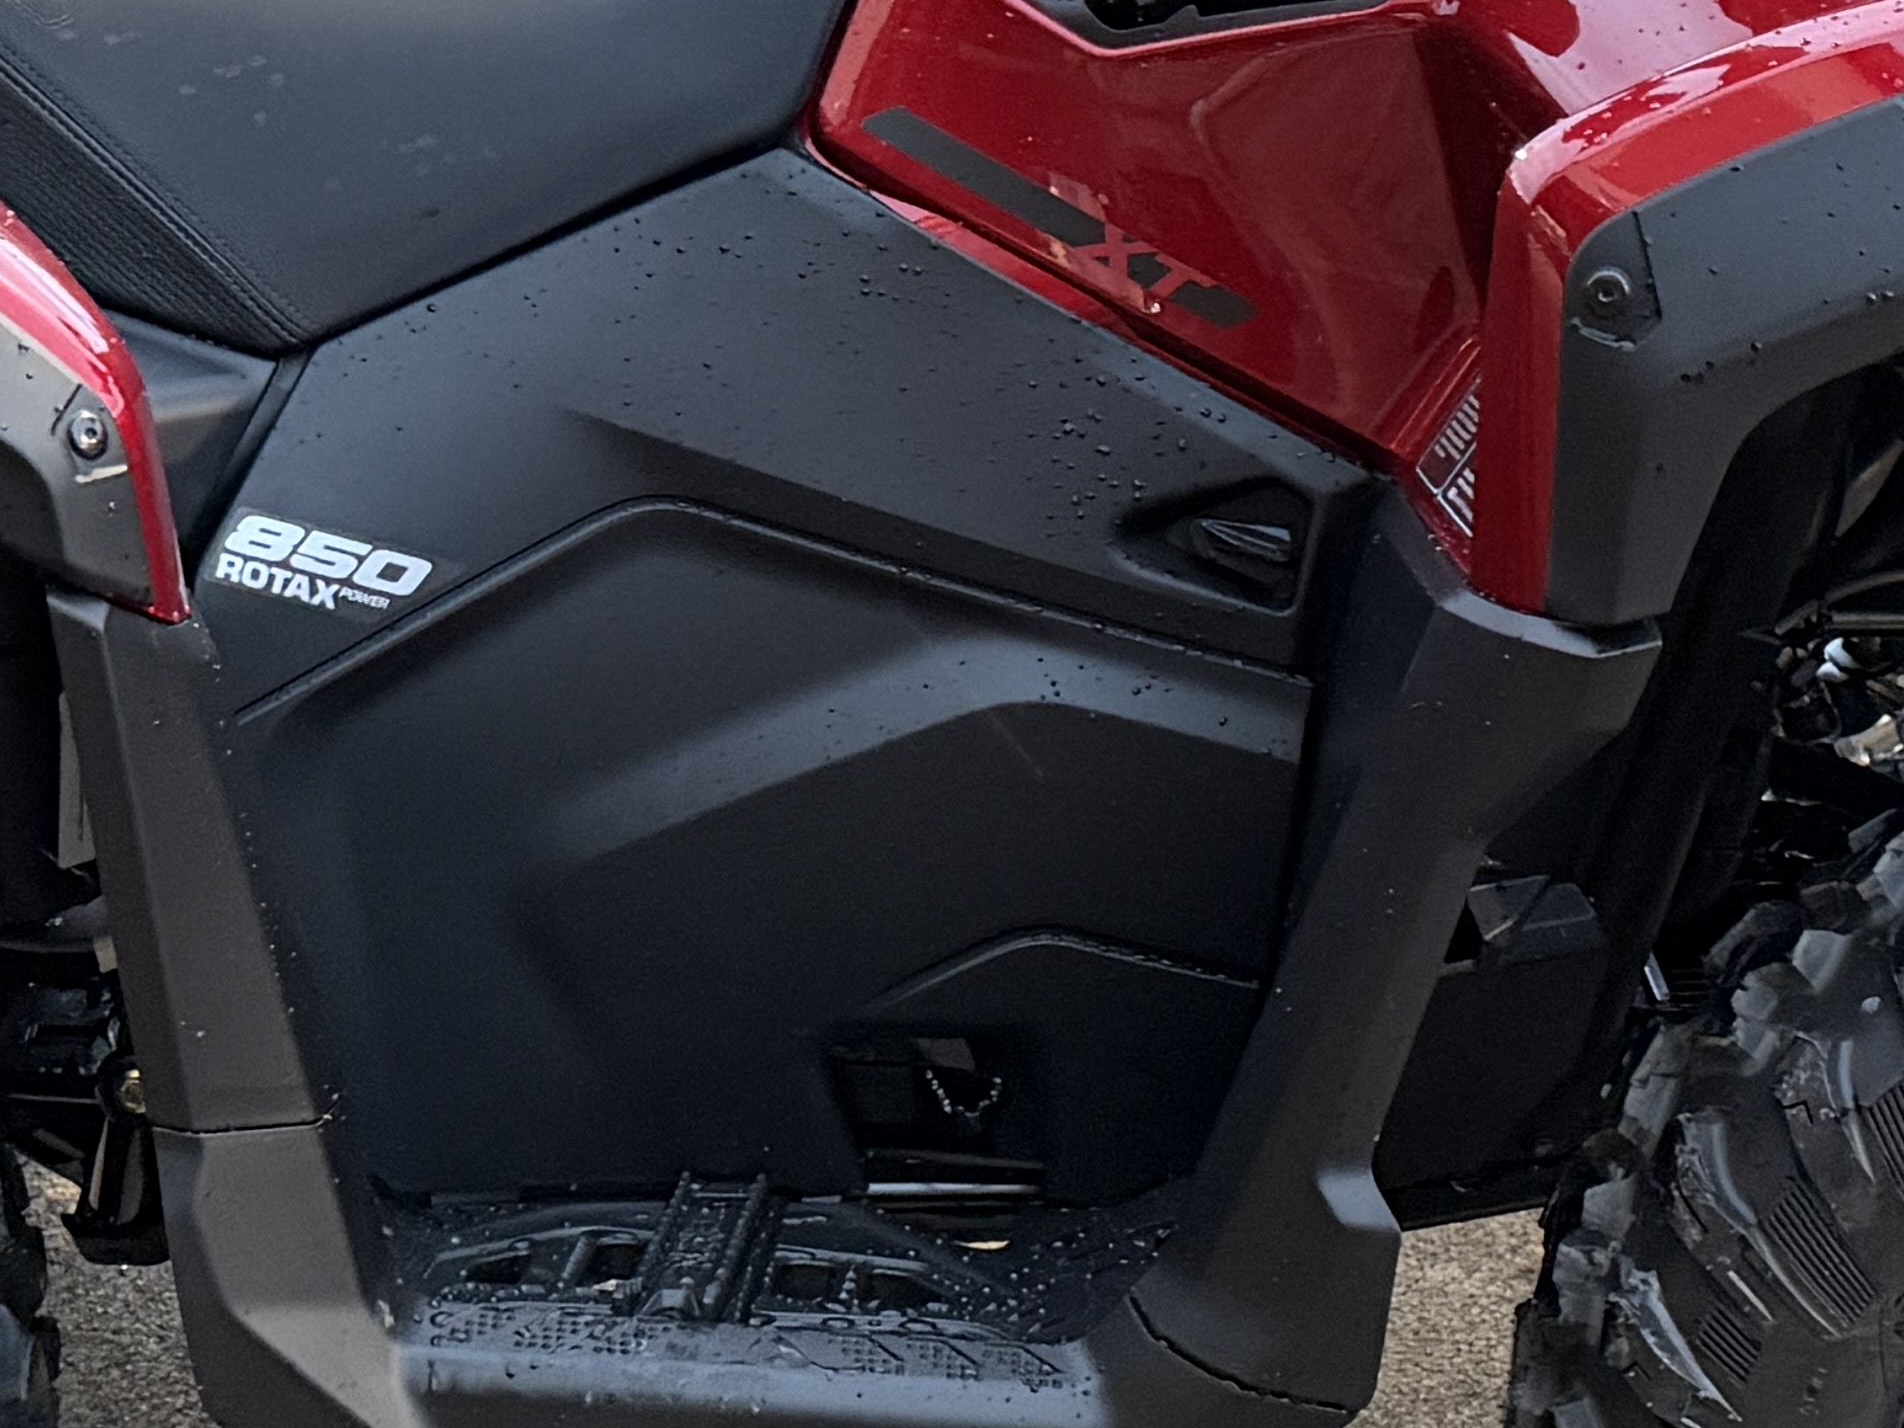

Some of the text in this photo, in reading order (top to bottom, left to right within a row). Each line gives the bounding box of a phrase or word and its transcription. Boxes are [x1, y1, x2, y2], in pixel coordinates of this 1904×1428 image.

[1070, 223, 1217, 299] XT
[214, 553, 391, 610] ROTAX POWER
[224, 515, 433, 596] 850
